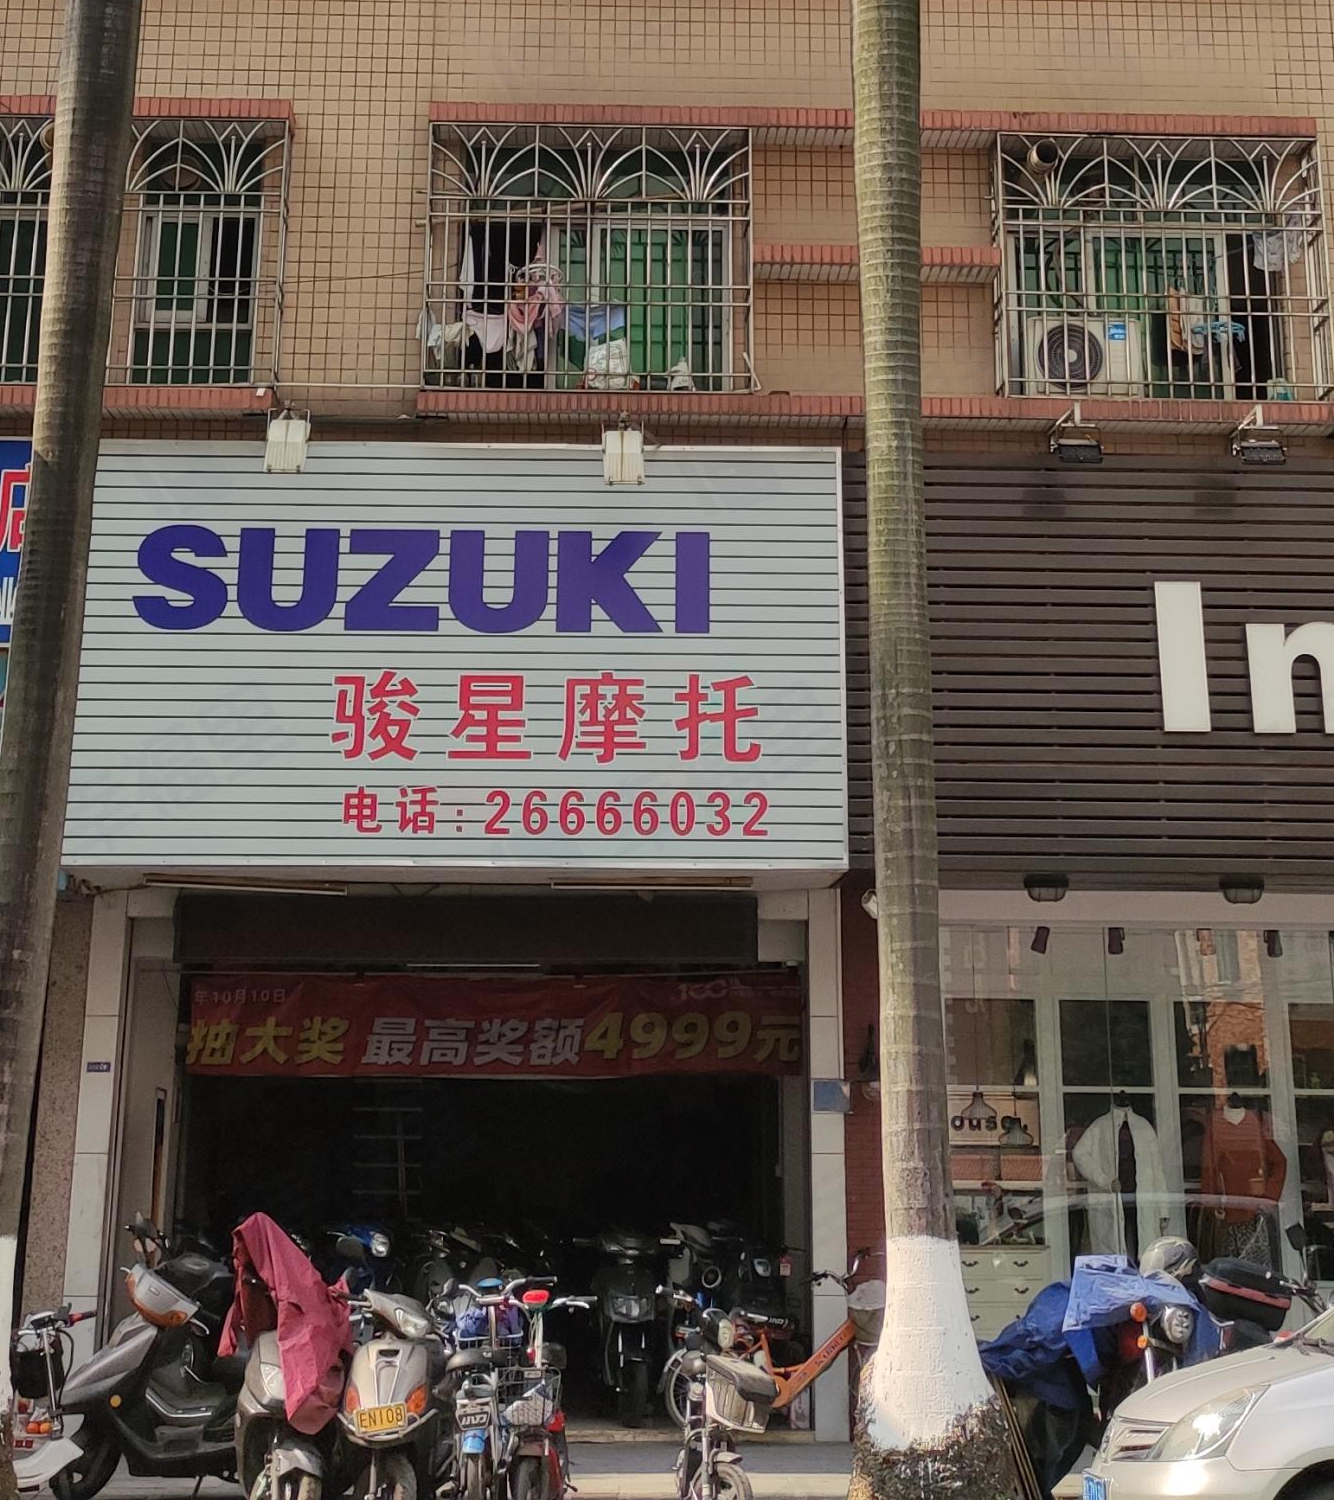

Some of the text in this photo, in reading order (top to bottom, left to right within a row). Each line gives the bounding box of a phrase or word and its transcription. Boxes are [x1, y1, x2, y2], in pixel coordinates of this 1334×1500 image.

[132, 524, 710, 634] SUZUKI
[330, 669, 763, 765] 骏星摩托
[342, 786, 770, 837] 电话:26666032
[186, 1010, 802, 1067] 抽大奖 最高奖额4999元
